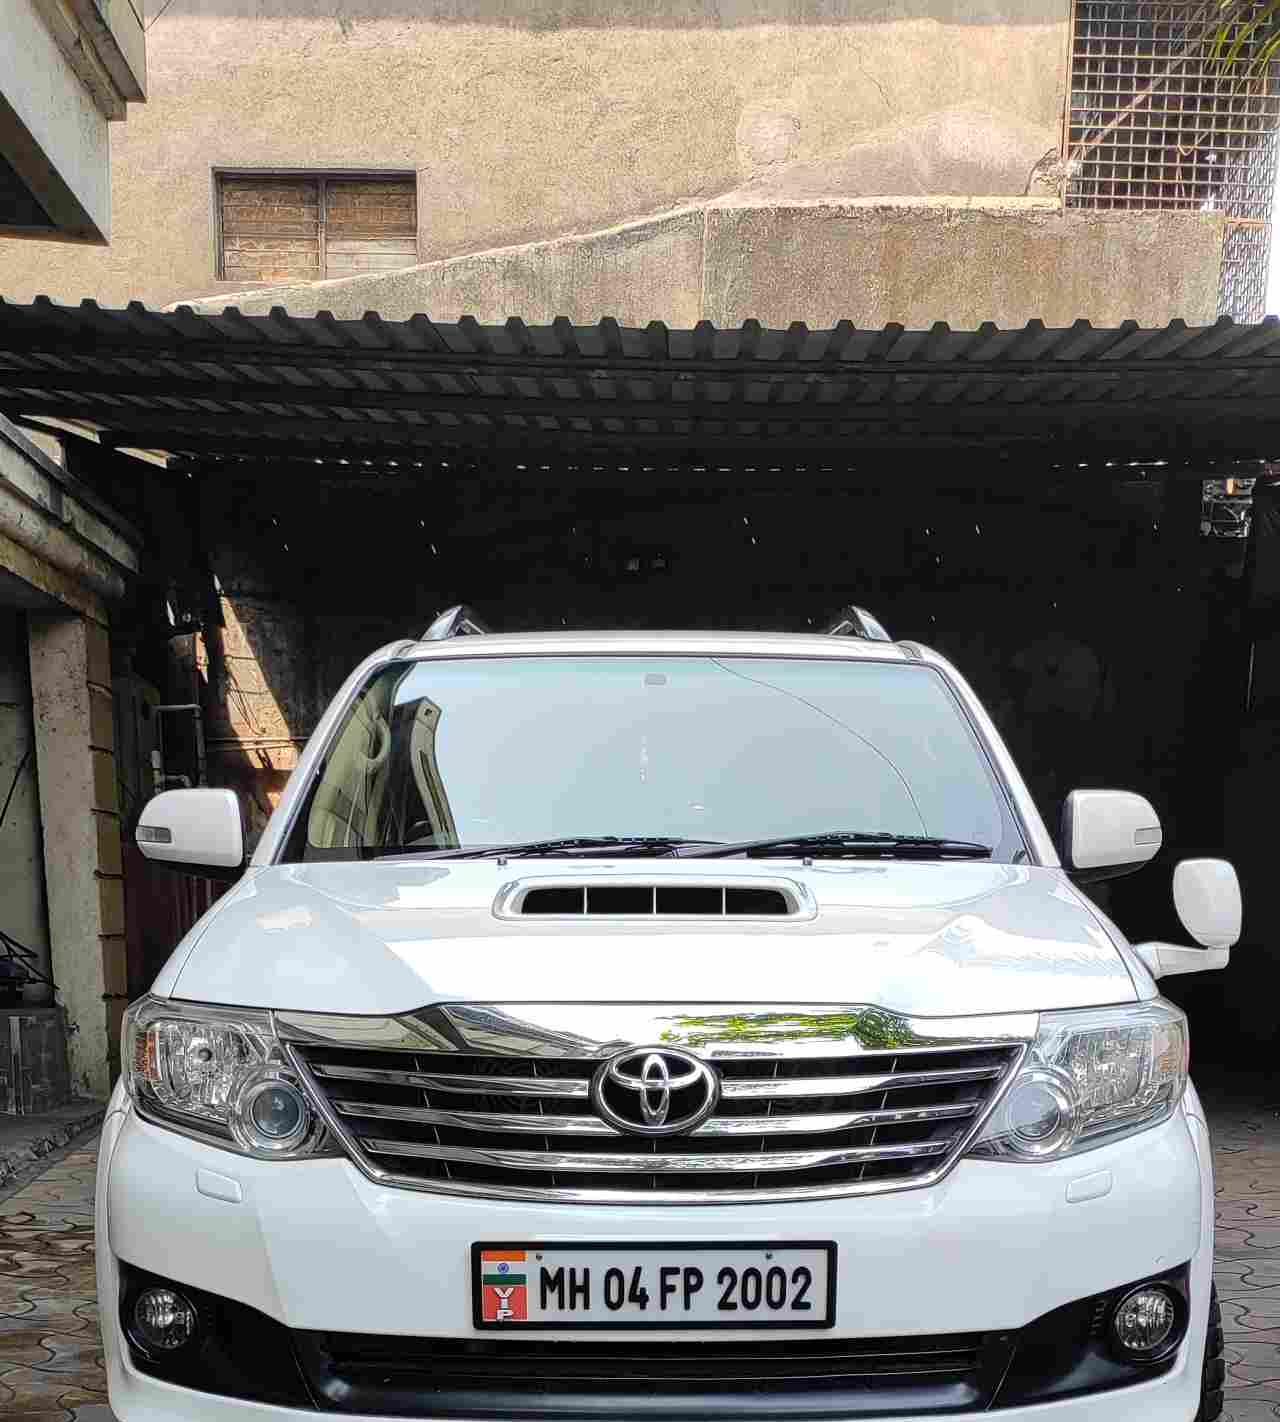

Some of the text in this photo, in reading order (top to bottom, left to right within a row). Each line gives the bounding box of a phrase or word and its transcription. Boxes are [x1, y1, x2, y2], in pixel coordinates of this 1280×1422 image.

[539, 1265, 813, 1312] MH 04 FP 2002
